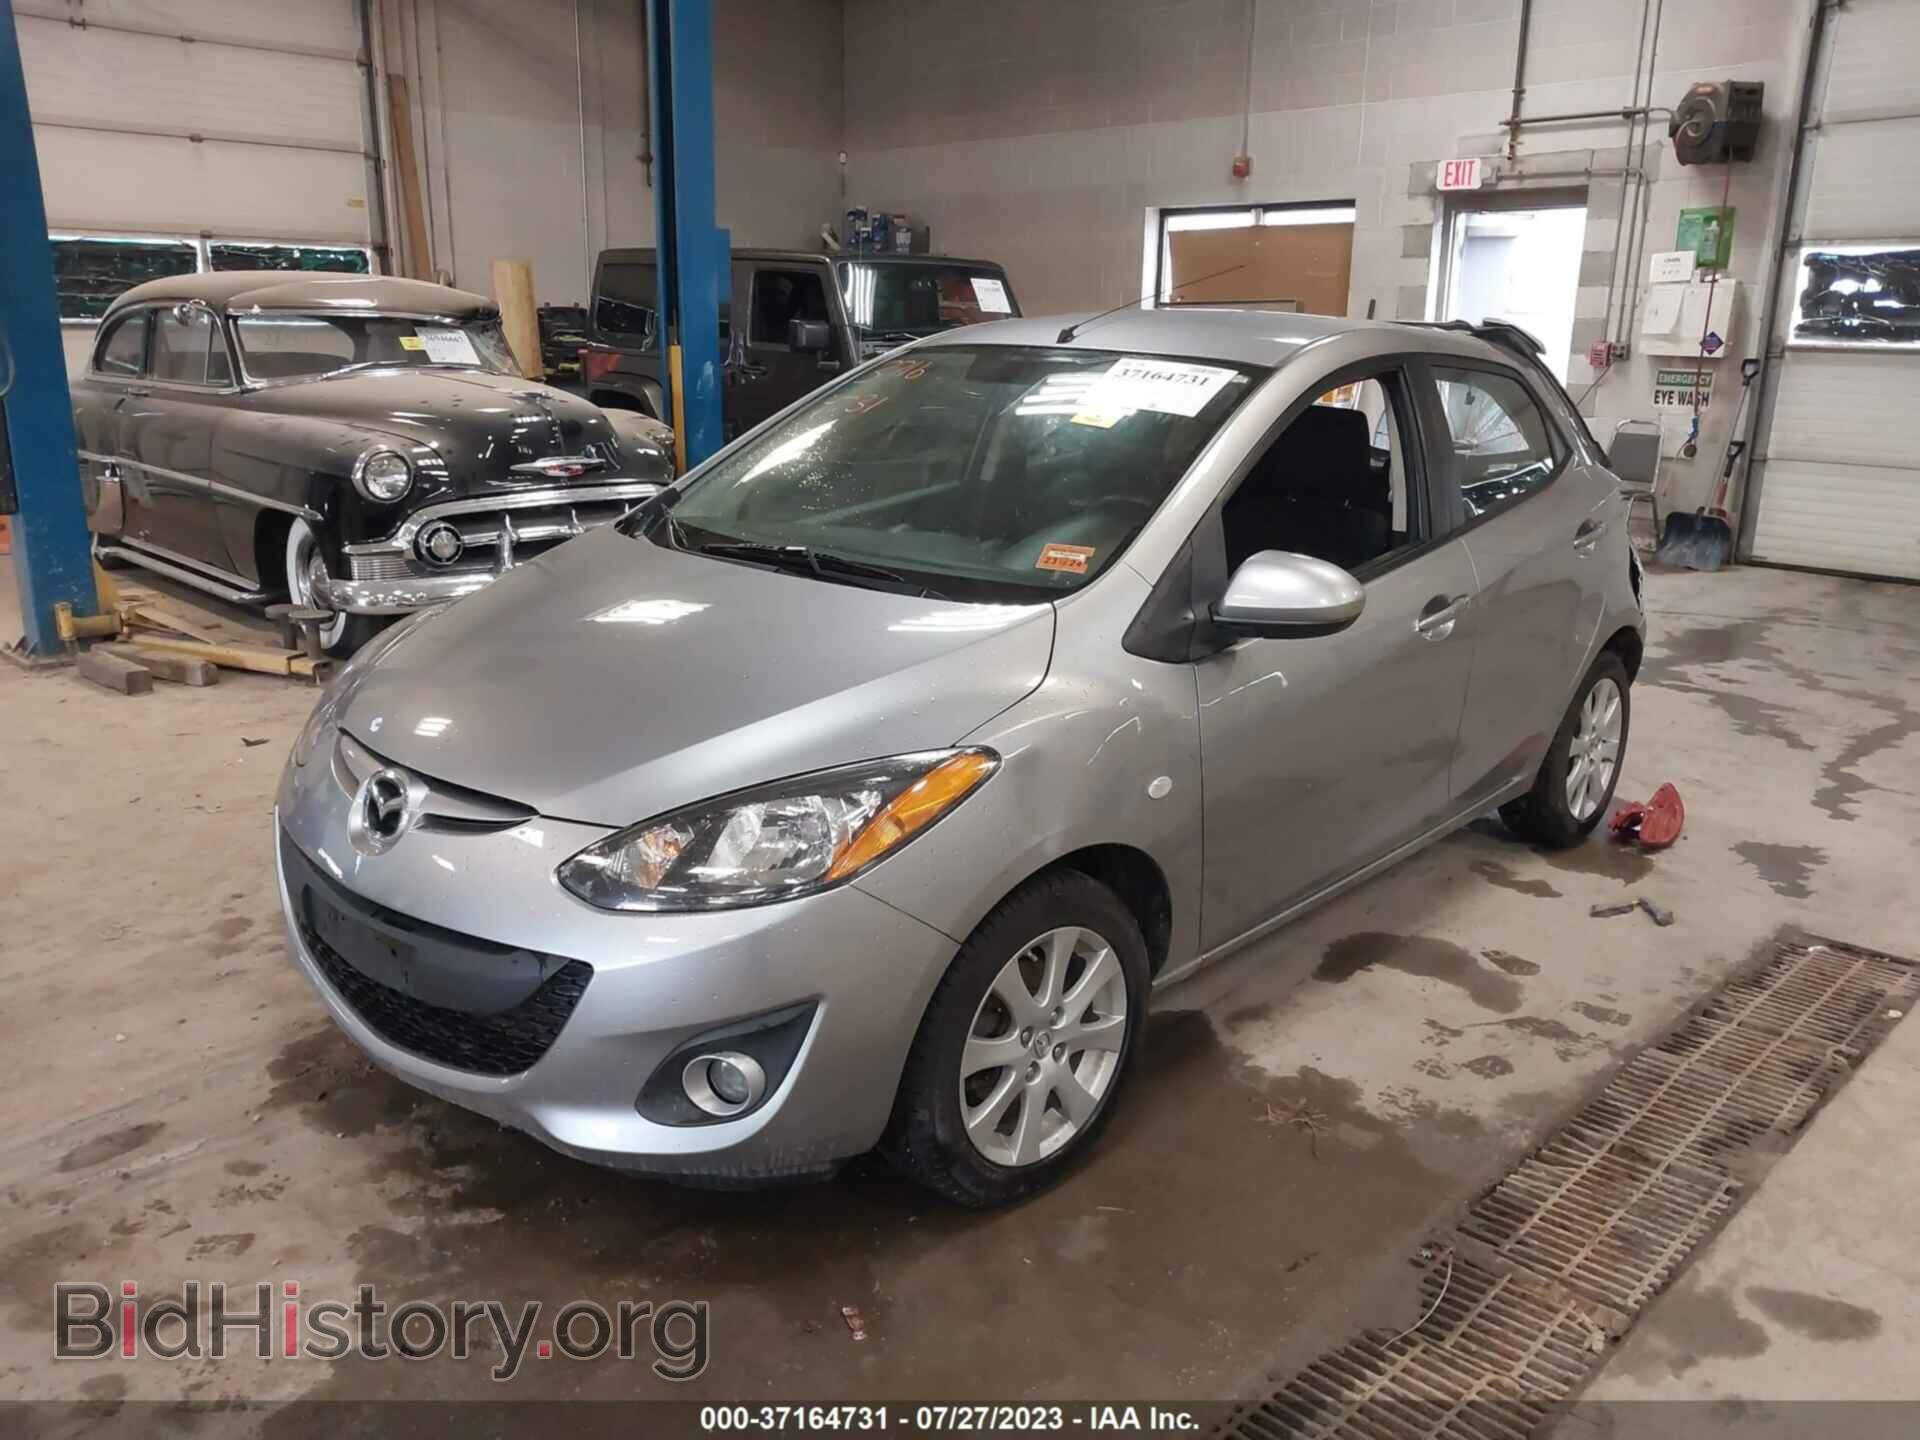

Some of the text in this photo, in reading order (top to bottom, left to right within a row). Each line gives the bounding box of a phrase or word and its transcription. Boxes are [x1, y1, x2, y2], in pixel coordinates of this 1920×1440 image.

[1443, 160, 1476, 187] EXIT
[1113, 368, 1210, 386] 37164731
[1654, 389, 1710, 407] EYE WASH
